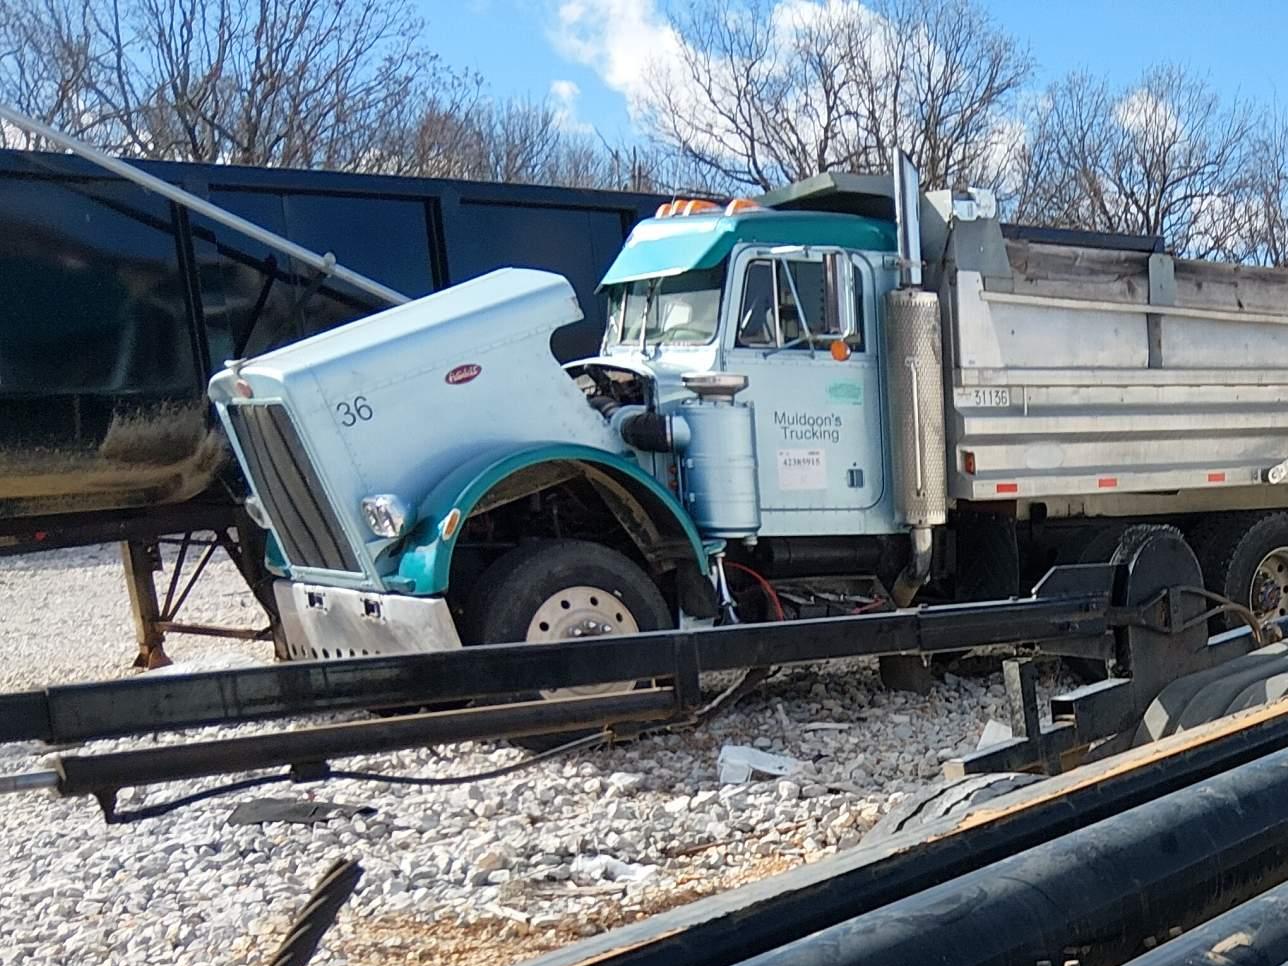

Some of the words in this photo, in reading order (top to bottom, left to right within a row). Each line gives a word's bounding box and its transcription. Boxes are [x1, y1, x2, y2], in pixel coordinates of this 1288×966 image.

[336, 395, 373, 427] 36
[774, 411, 842, 427] Muldoon's
[782, 426, 840, 443] Trucking
